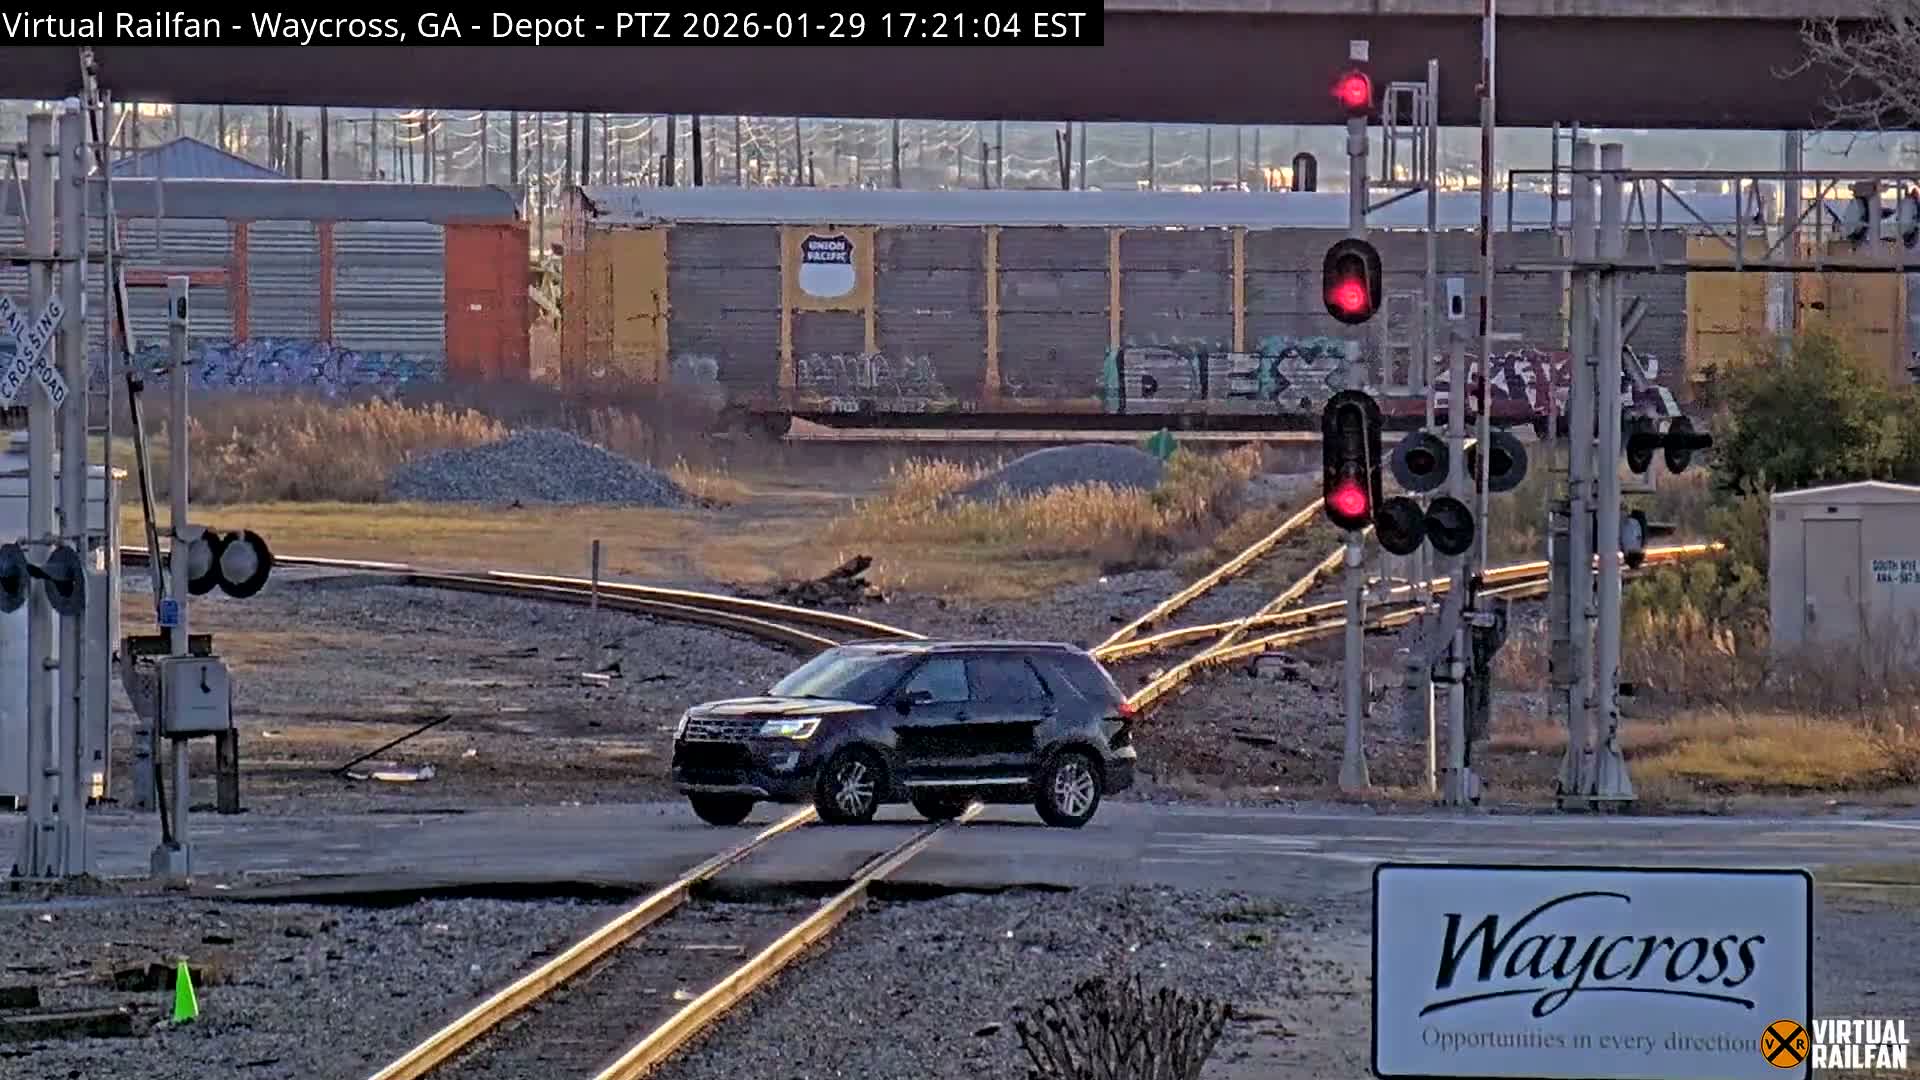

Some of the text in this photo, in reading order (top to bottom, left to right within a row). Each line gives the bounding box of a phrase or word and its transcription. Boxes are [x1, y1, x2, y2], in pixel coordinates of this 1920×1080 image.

[808, 241, 845, 251] UNION
[0, 298, 24, 343] RAIL
[1, 302, 61, 400] CROSSING
[36, 356, 65, 402] ROAD
[1435, 891, 1766, 1017] Waycross
[1422, 1025, 1757, 1056] Opportunities in every direction
